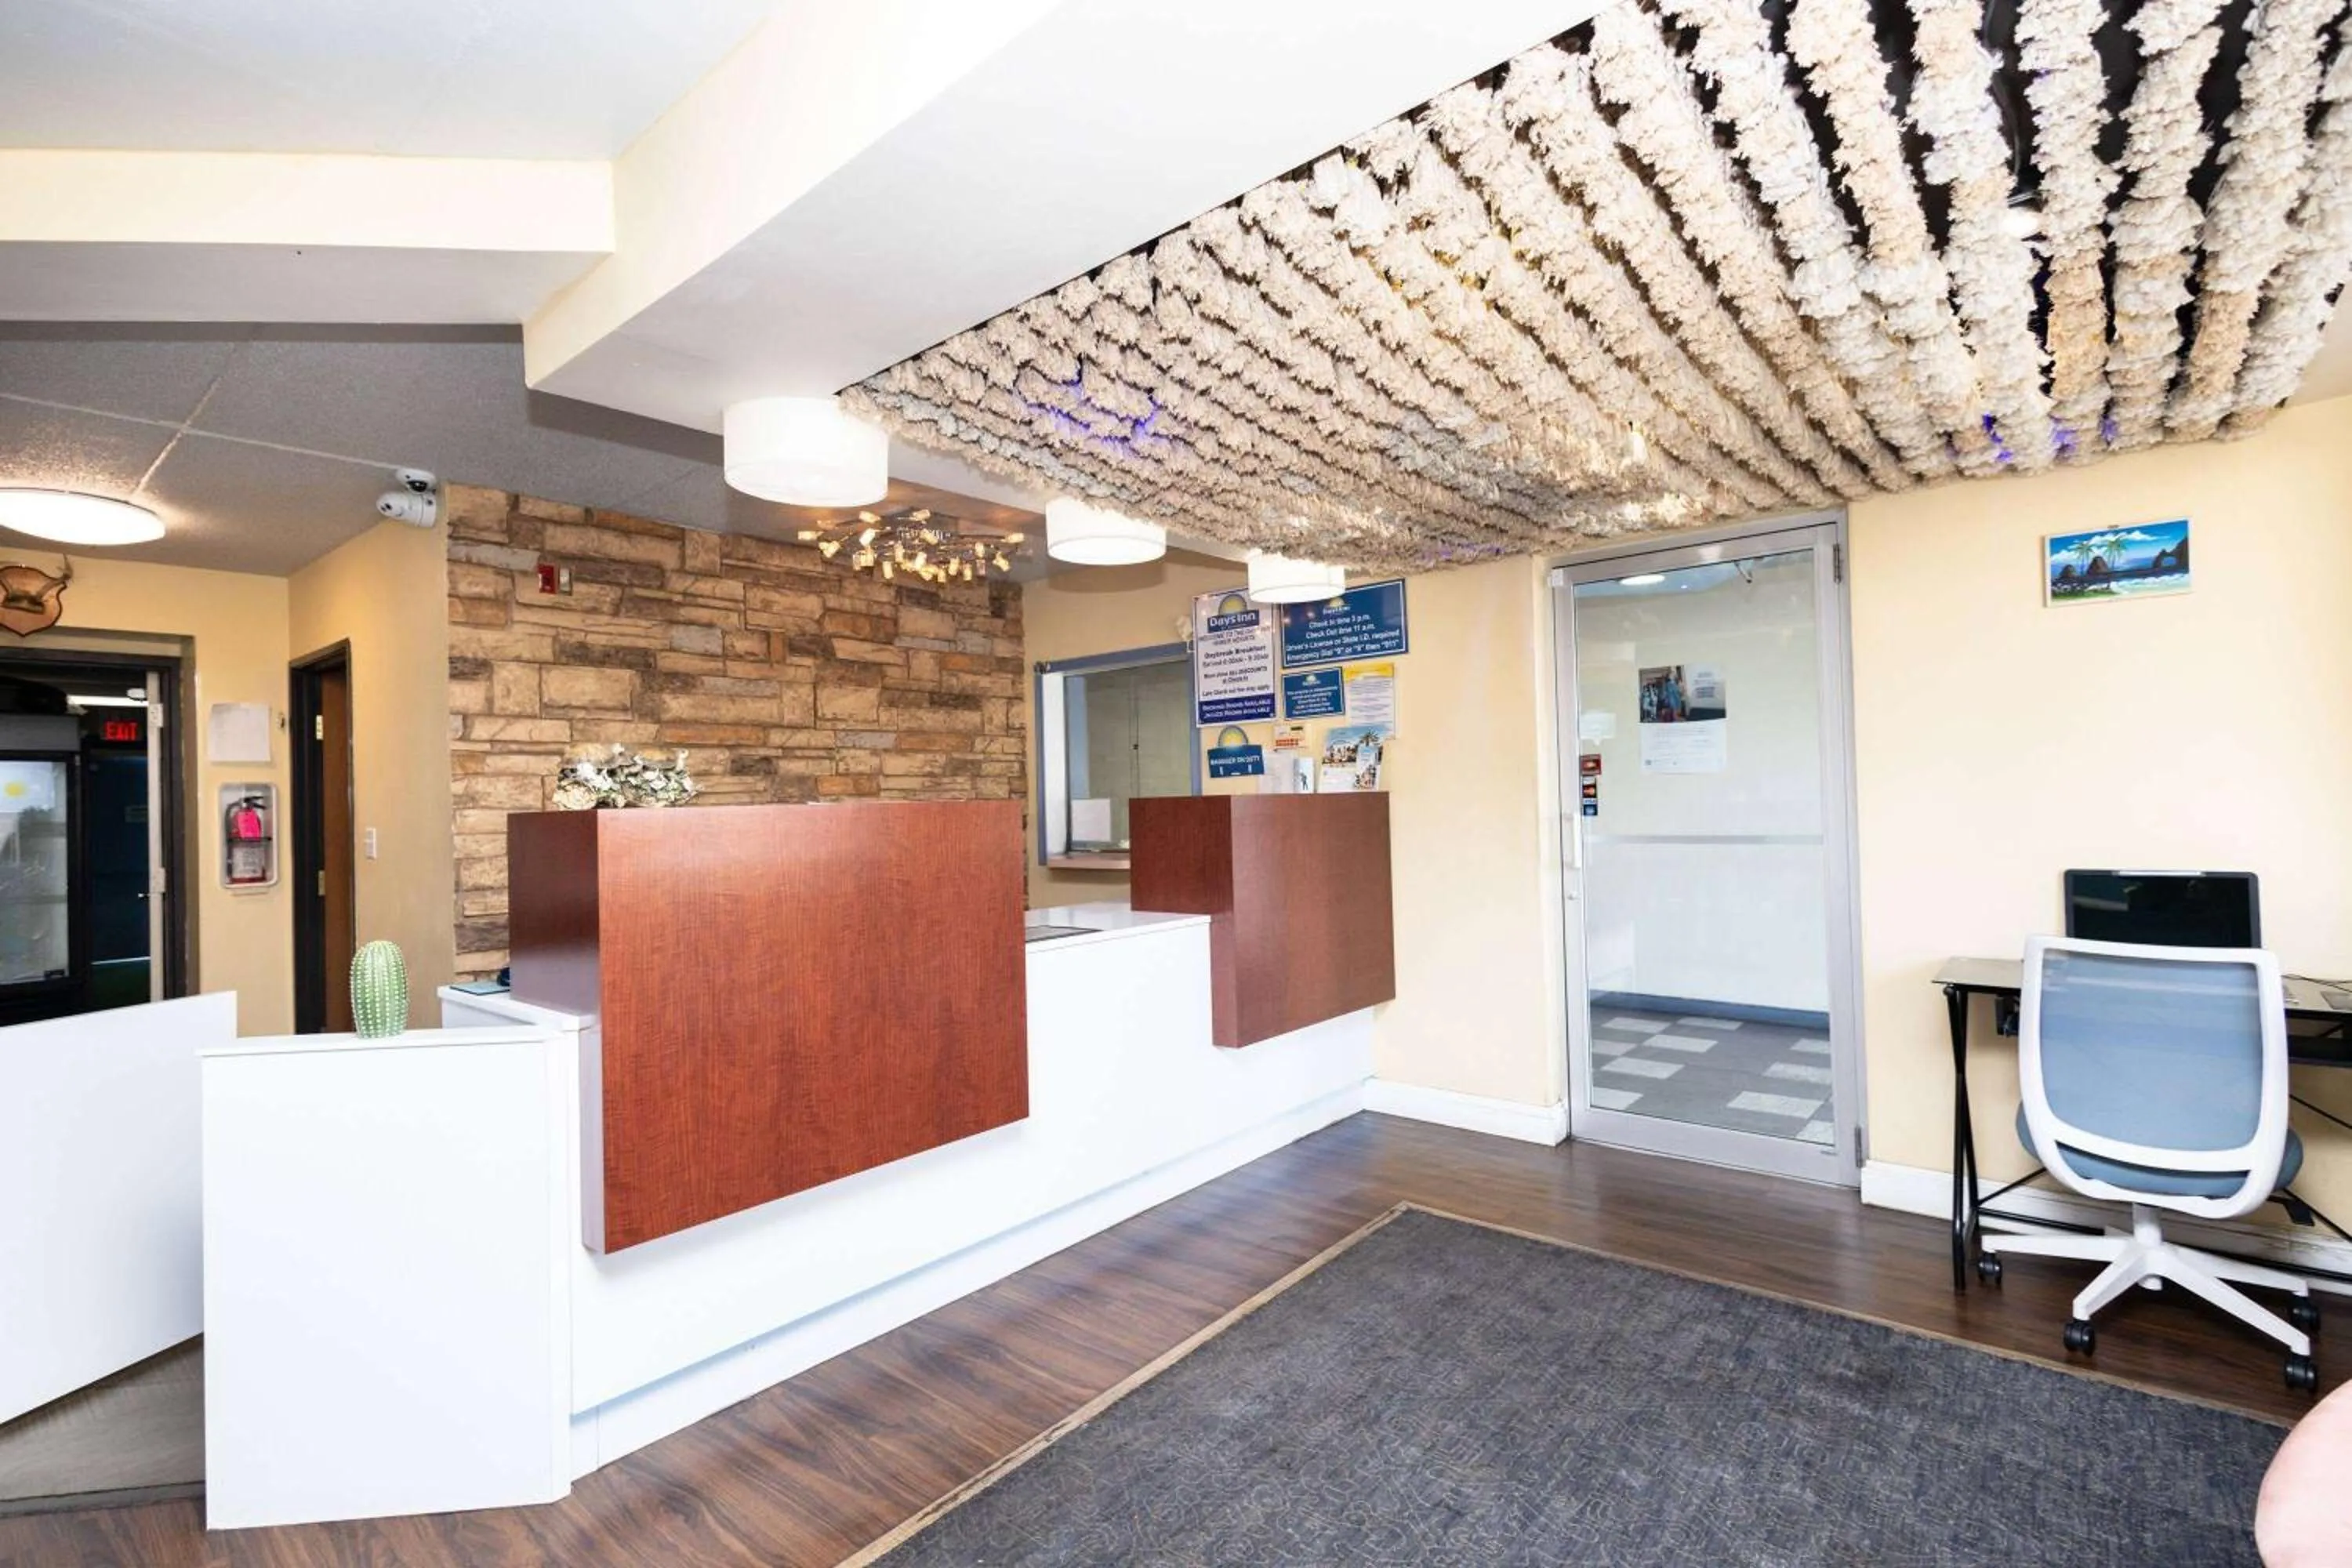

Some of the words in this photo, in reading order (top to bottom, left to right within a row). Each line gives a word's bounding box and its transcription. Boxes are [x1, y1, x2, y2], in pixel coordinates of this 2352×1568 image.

[1210, 615, 1236, 626] Days
[1308, 619, 1328, 629] Check
[1305, 630, 1324, 639] Check
[1372, 629, 1399, 640] required
[107, 721, 137, 741] EXIT
